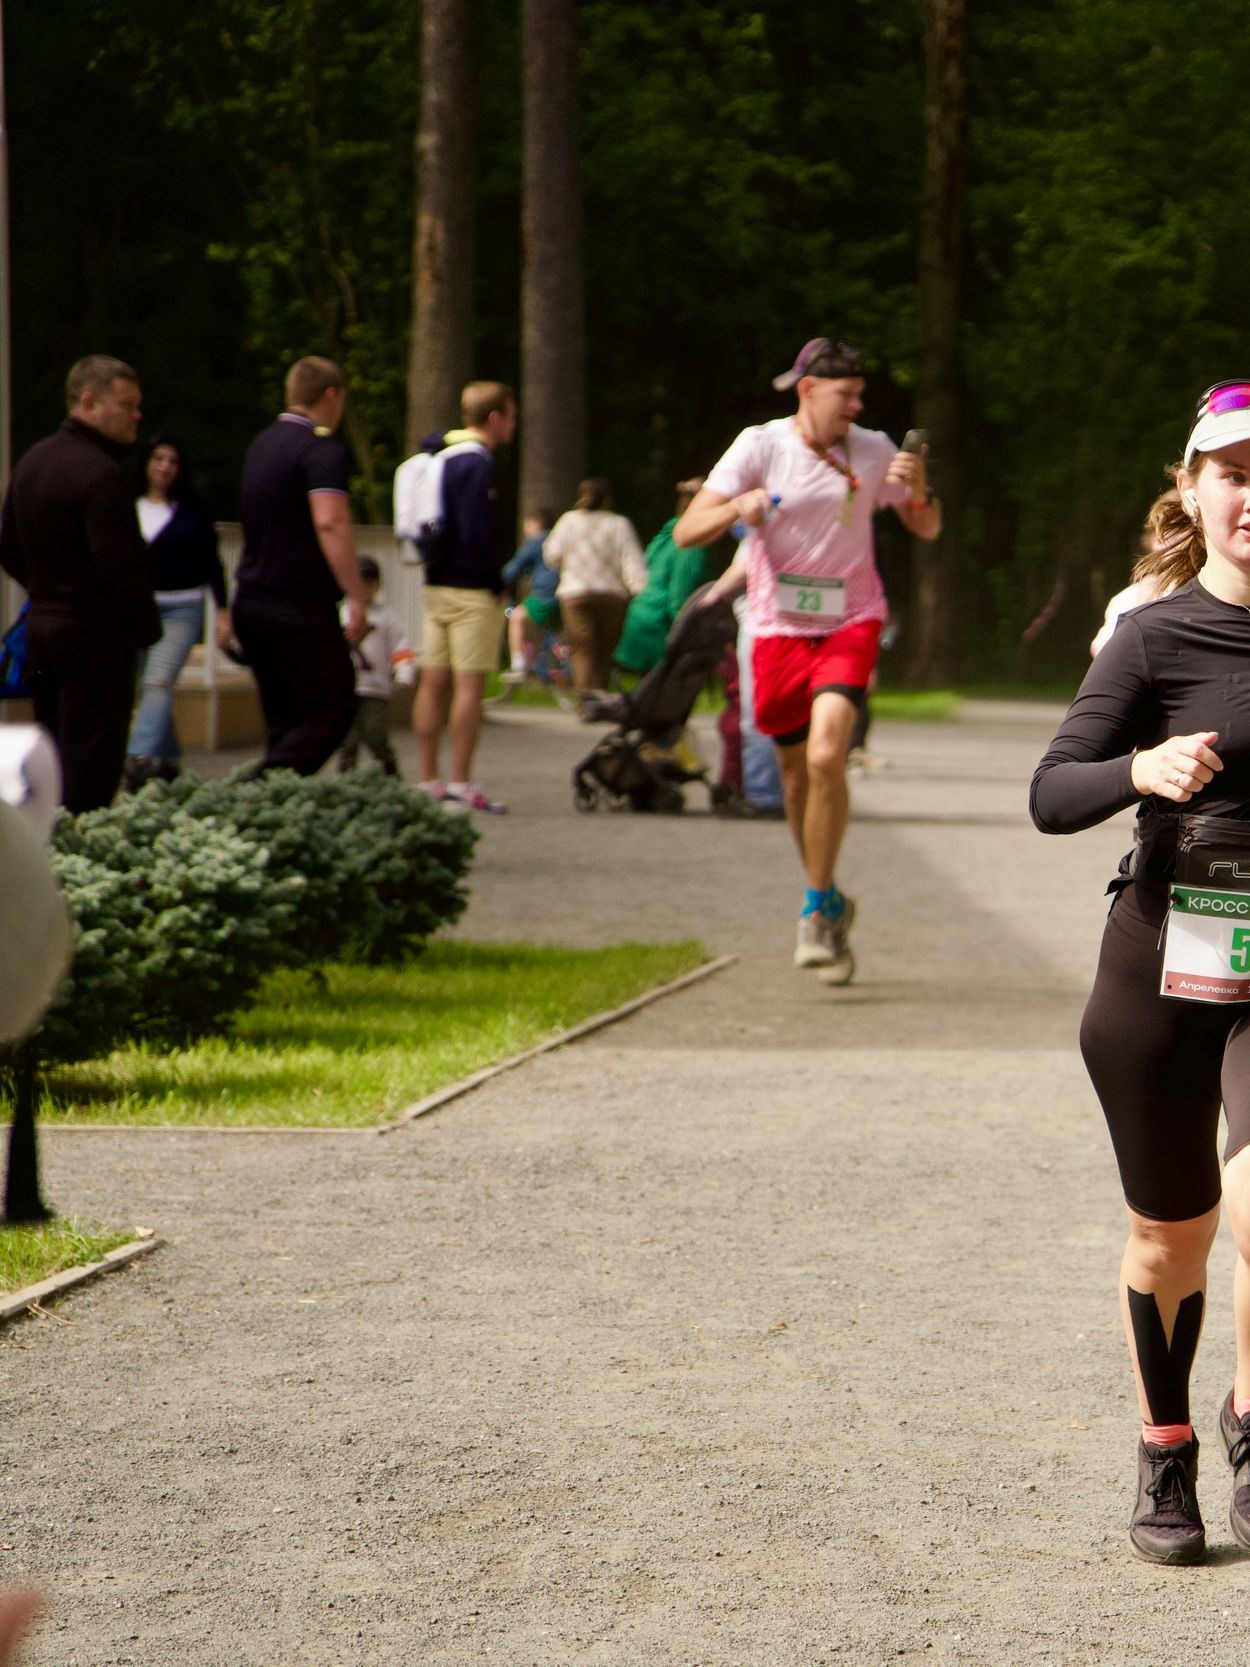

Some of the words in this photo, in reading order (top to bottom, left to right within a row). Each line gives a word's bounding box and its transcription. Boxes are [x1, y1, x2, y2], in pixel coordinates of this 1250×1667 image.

[797, 591, 822, 612] 23
[1187, 896, 1249, 914] КРОСС
[1178, 980, 1239, 995] Апрелевка
